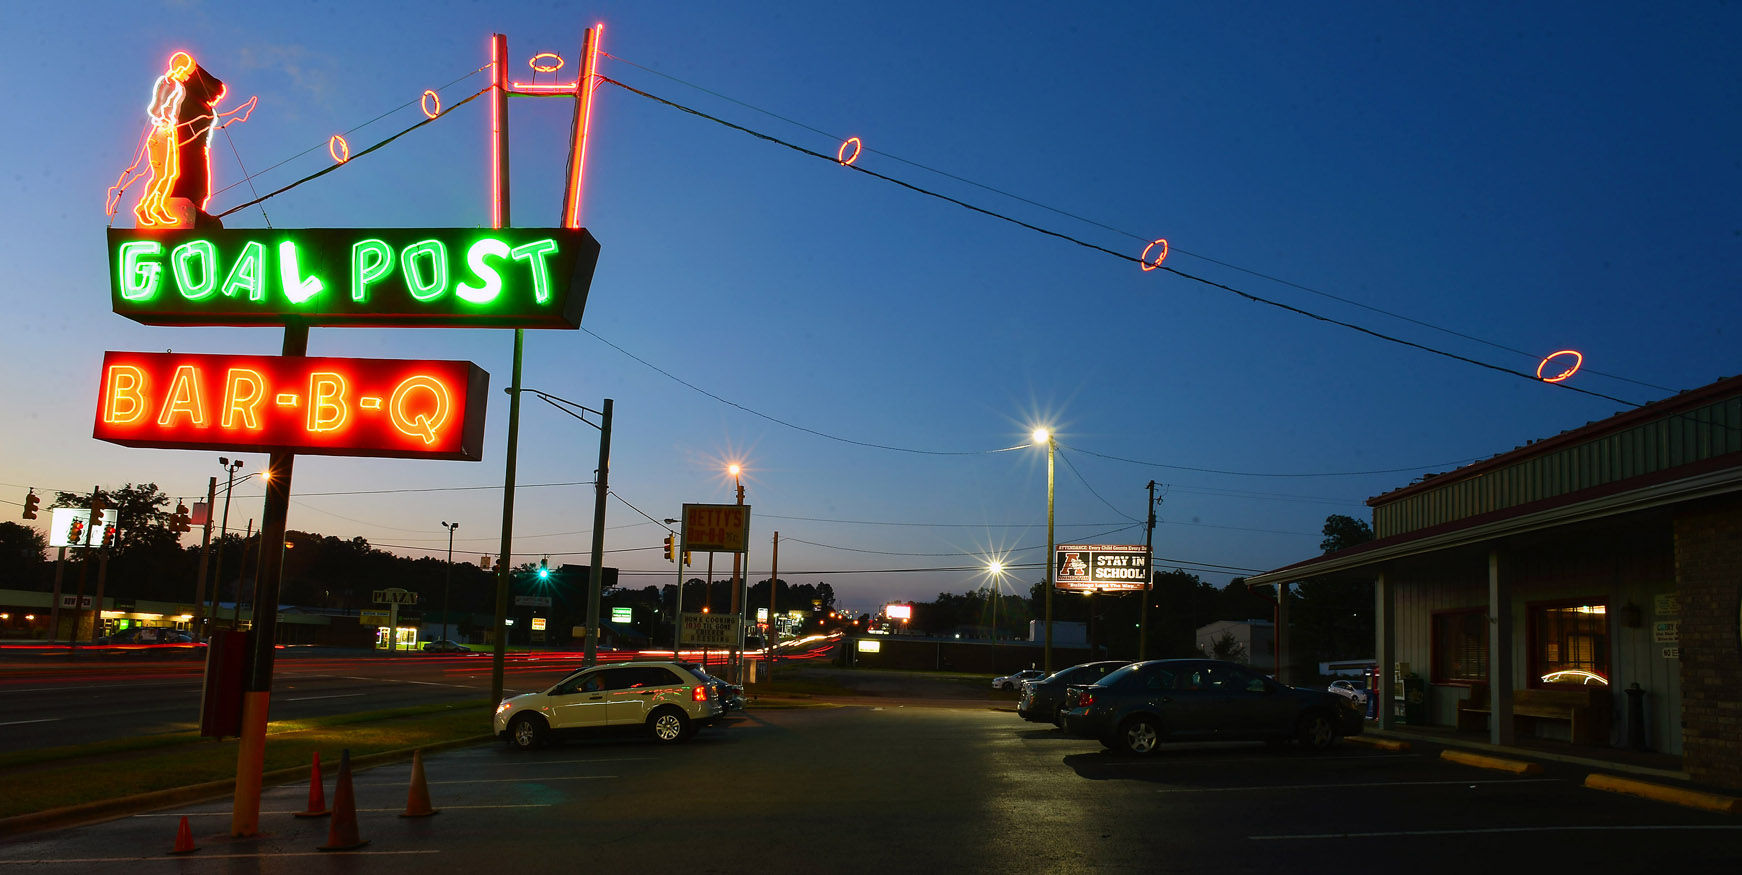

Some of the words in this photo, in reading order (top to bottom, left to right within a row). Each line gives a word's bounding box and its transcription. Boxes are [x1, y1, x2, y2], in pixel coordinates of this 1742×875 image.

[118, 240, 325, 304] GOAL
[352, 237, 559, 305] POST
[103, 365, 450, 445] BAR-B-Q
[689, 508, 742, 528] BETTY'S
[1097, 555, 1129, 566] STAY
[1131, 556, 1145, 566] IN
[1096, 568, 1146, 579] SCHOOL!
[374, 591, 416, 604] PLAZA
[705, 616, 736, 624] COOKING
